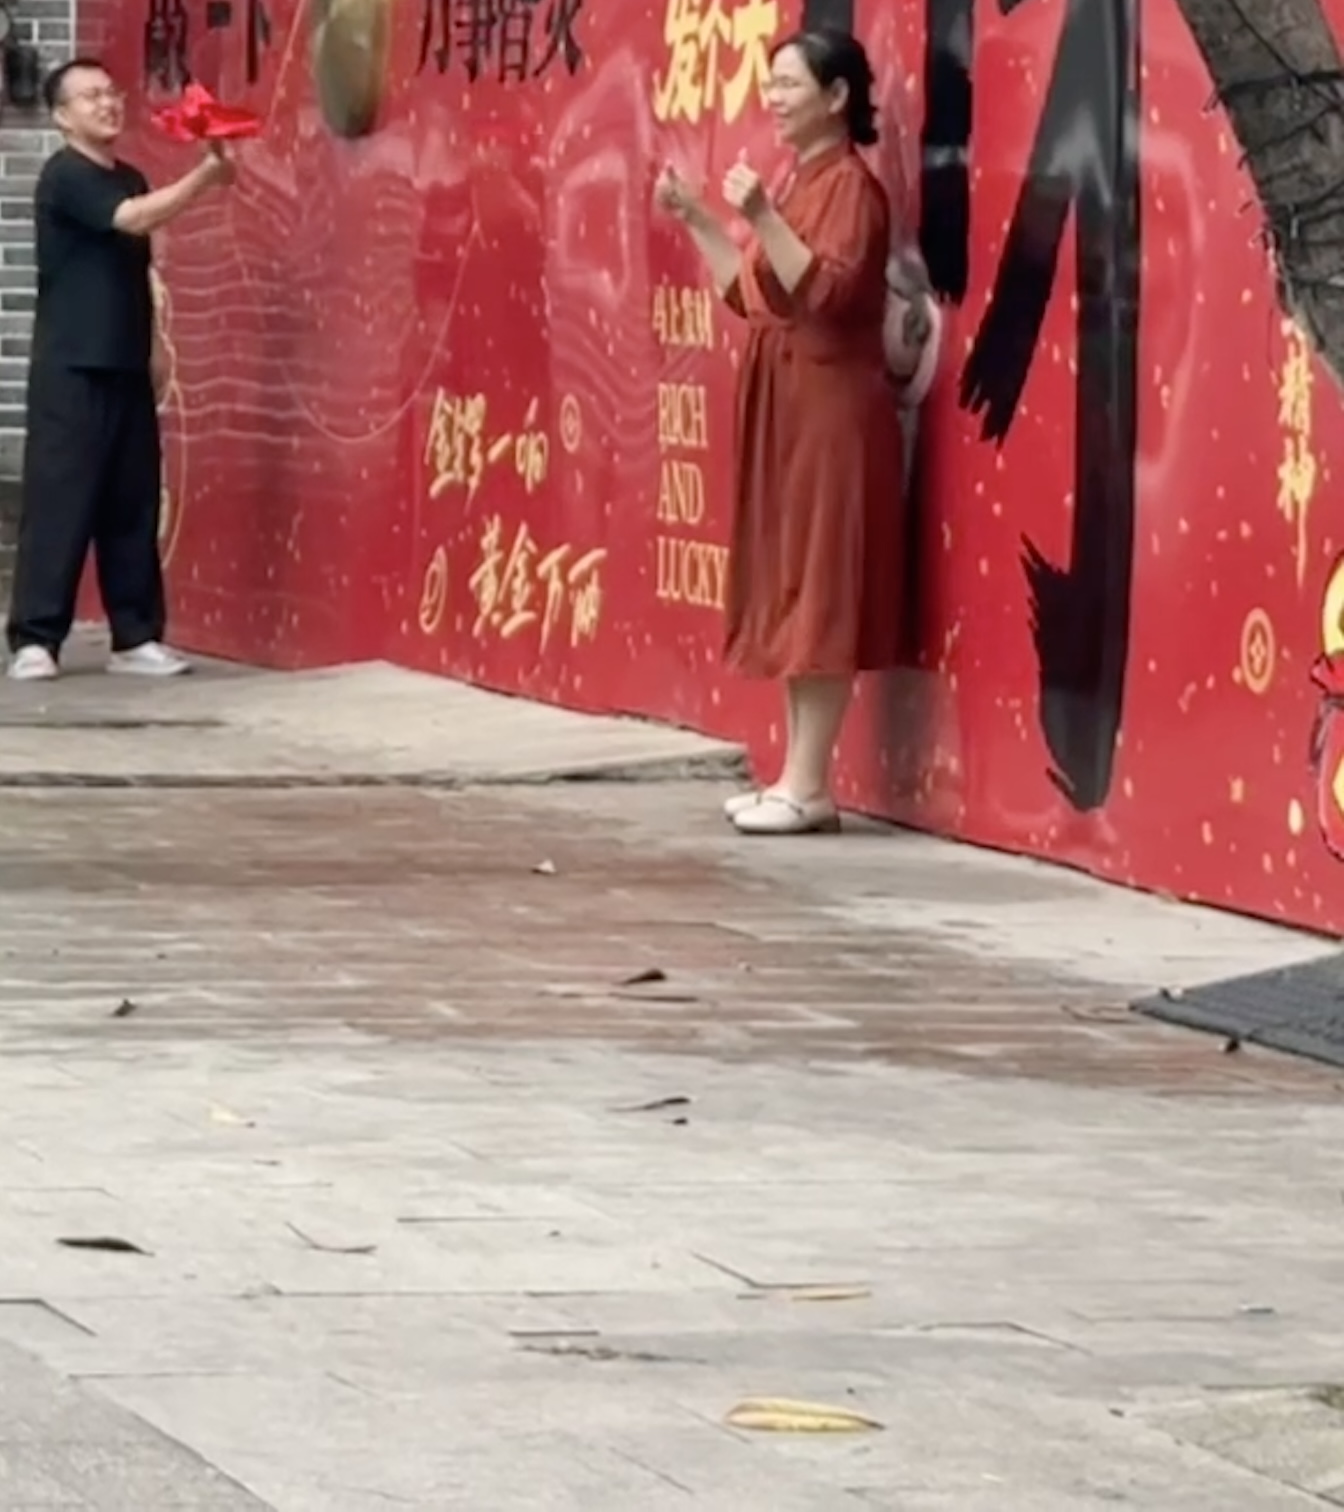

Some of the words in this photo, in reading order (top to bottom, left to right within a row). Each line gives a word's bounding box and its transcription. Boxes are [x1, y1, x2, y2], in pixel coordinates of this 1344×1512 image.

[657, 382, 709, 449] RICH
[656, 459, 705, 525] AND
[656, 535, 730, 610] LUCKY
